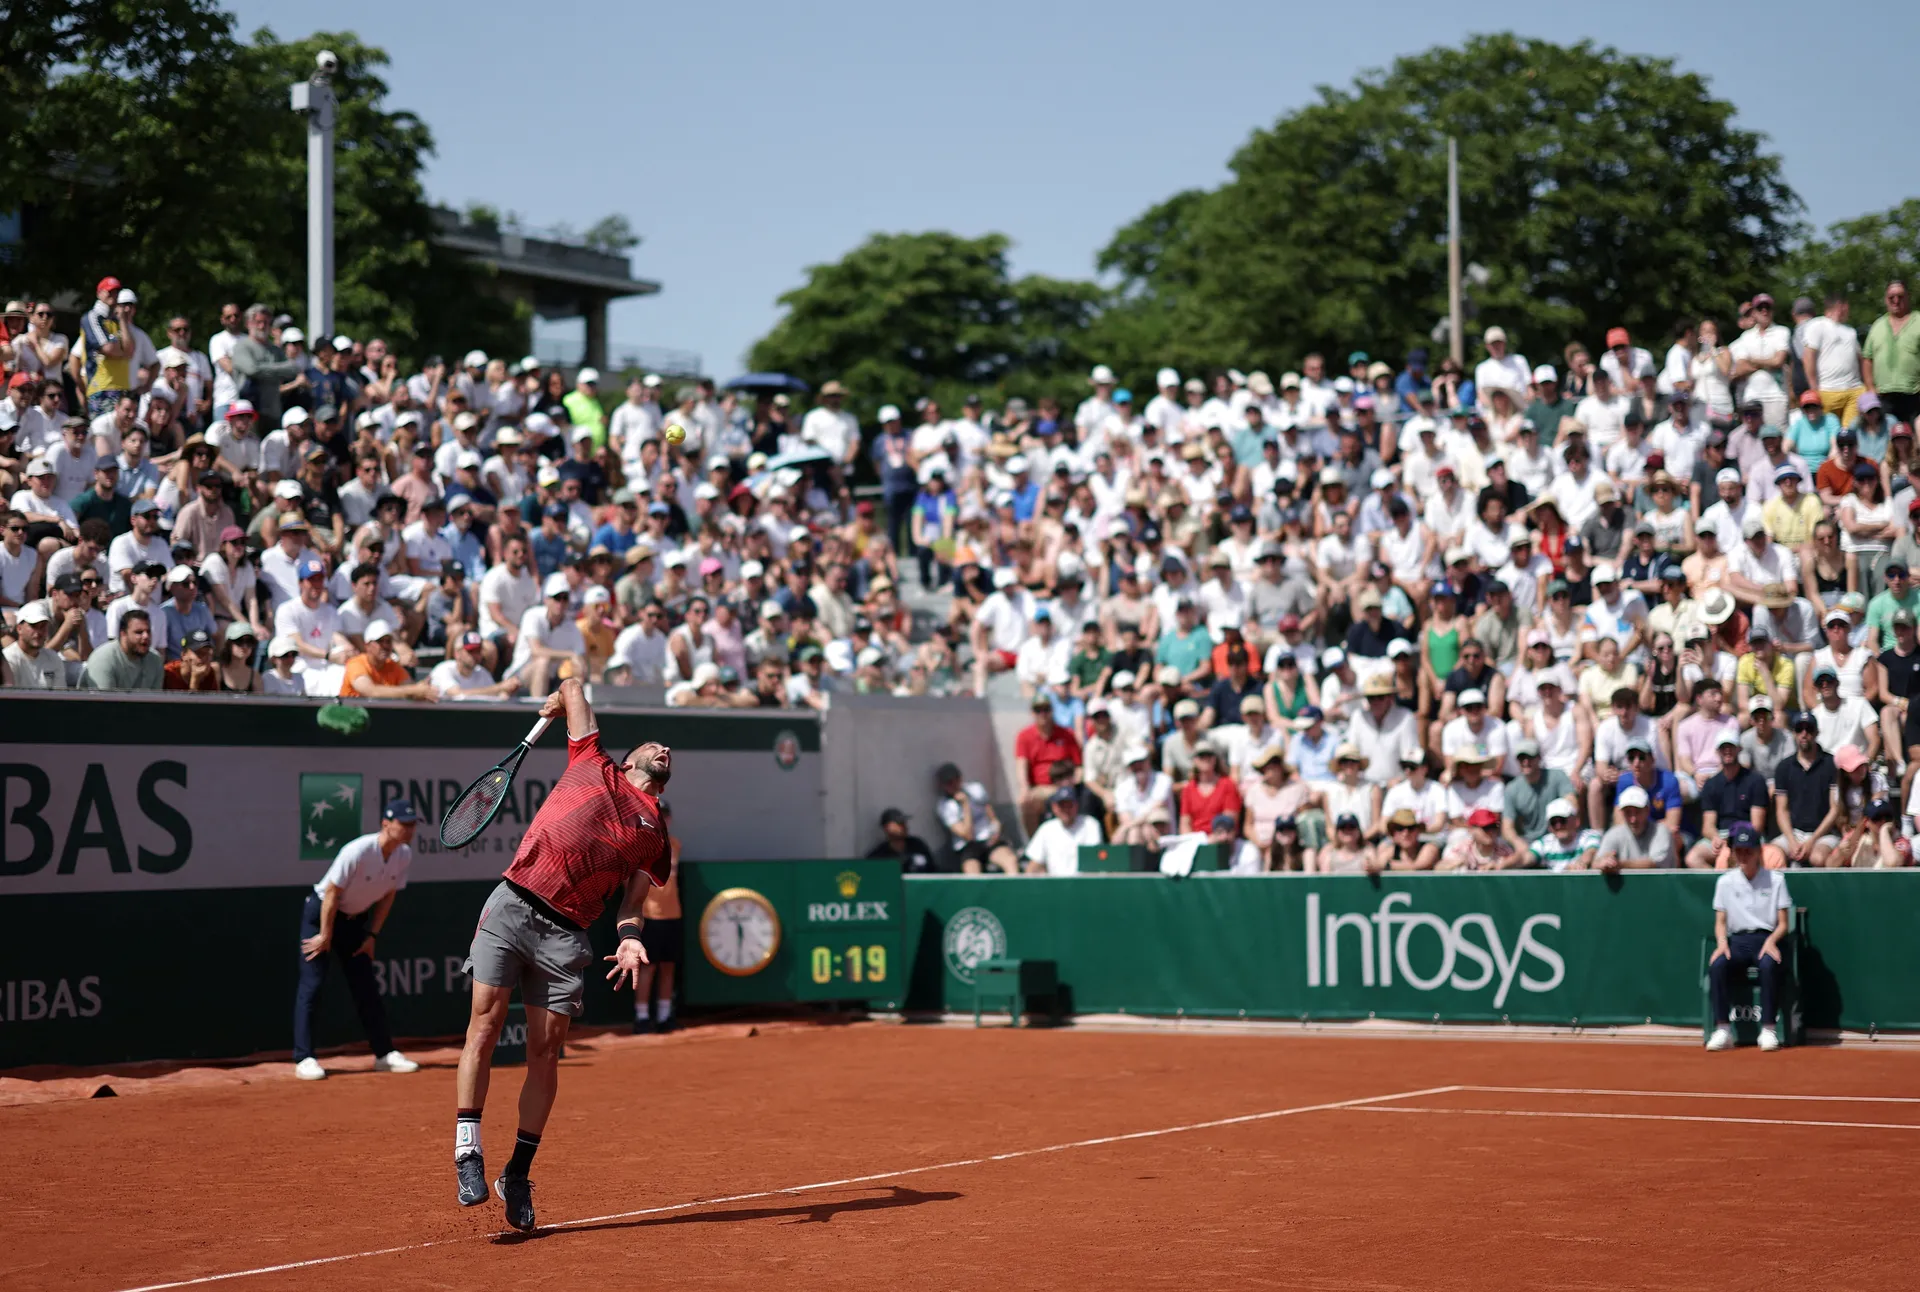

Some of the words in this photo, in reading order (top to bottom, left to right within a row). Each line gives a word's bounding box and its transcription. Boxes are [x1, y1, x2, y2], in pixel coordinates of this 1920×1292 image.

[0, 760, 193, 876] BAS
[808, 901, 889, 921] ROLEX
[812, 944, 887, 984] 0:19
[1306, 891, 1565, 1009] Infosys
[0, 975, 102, 1021] IBAS
